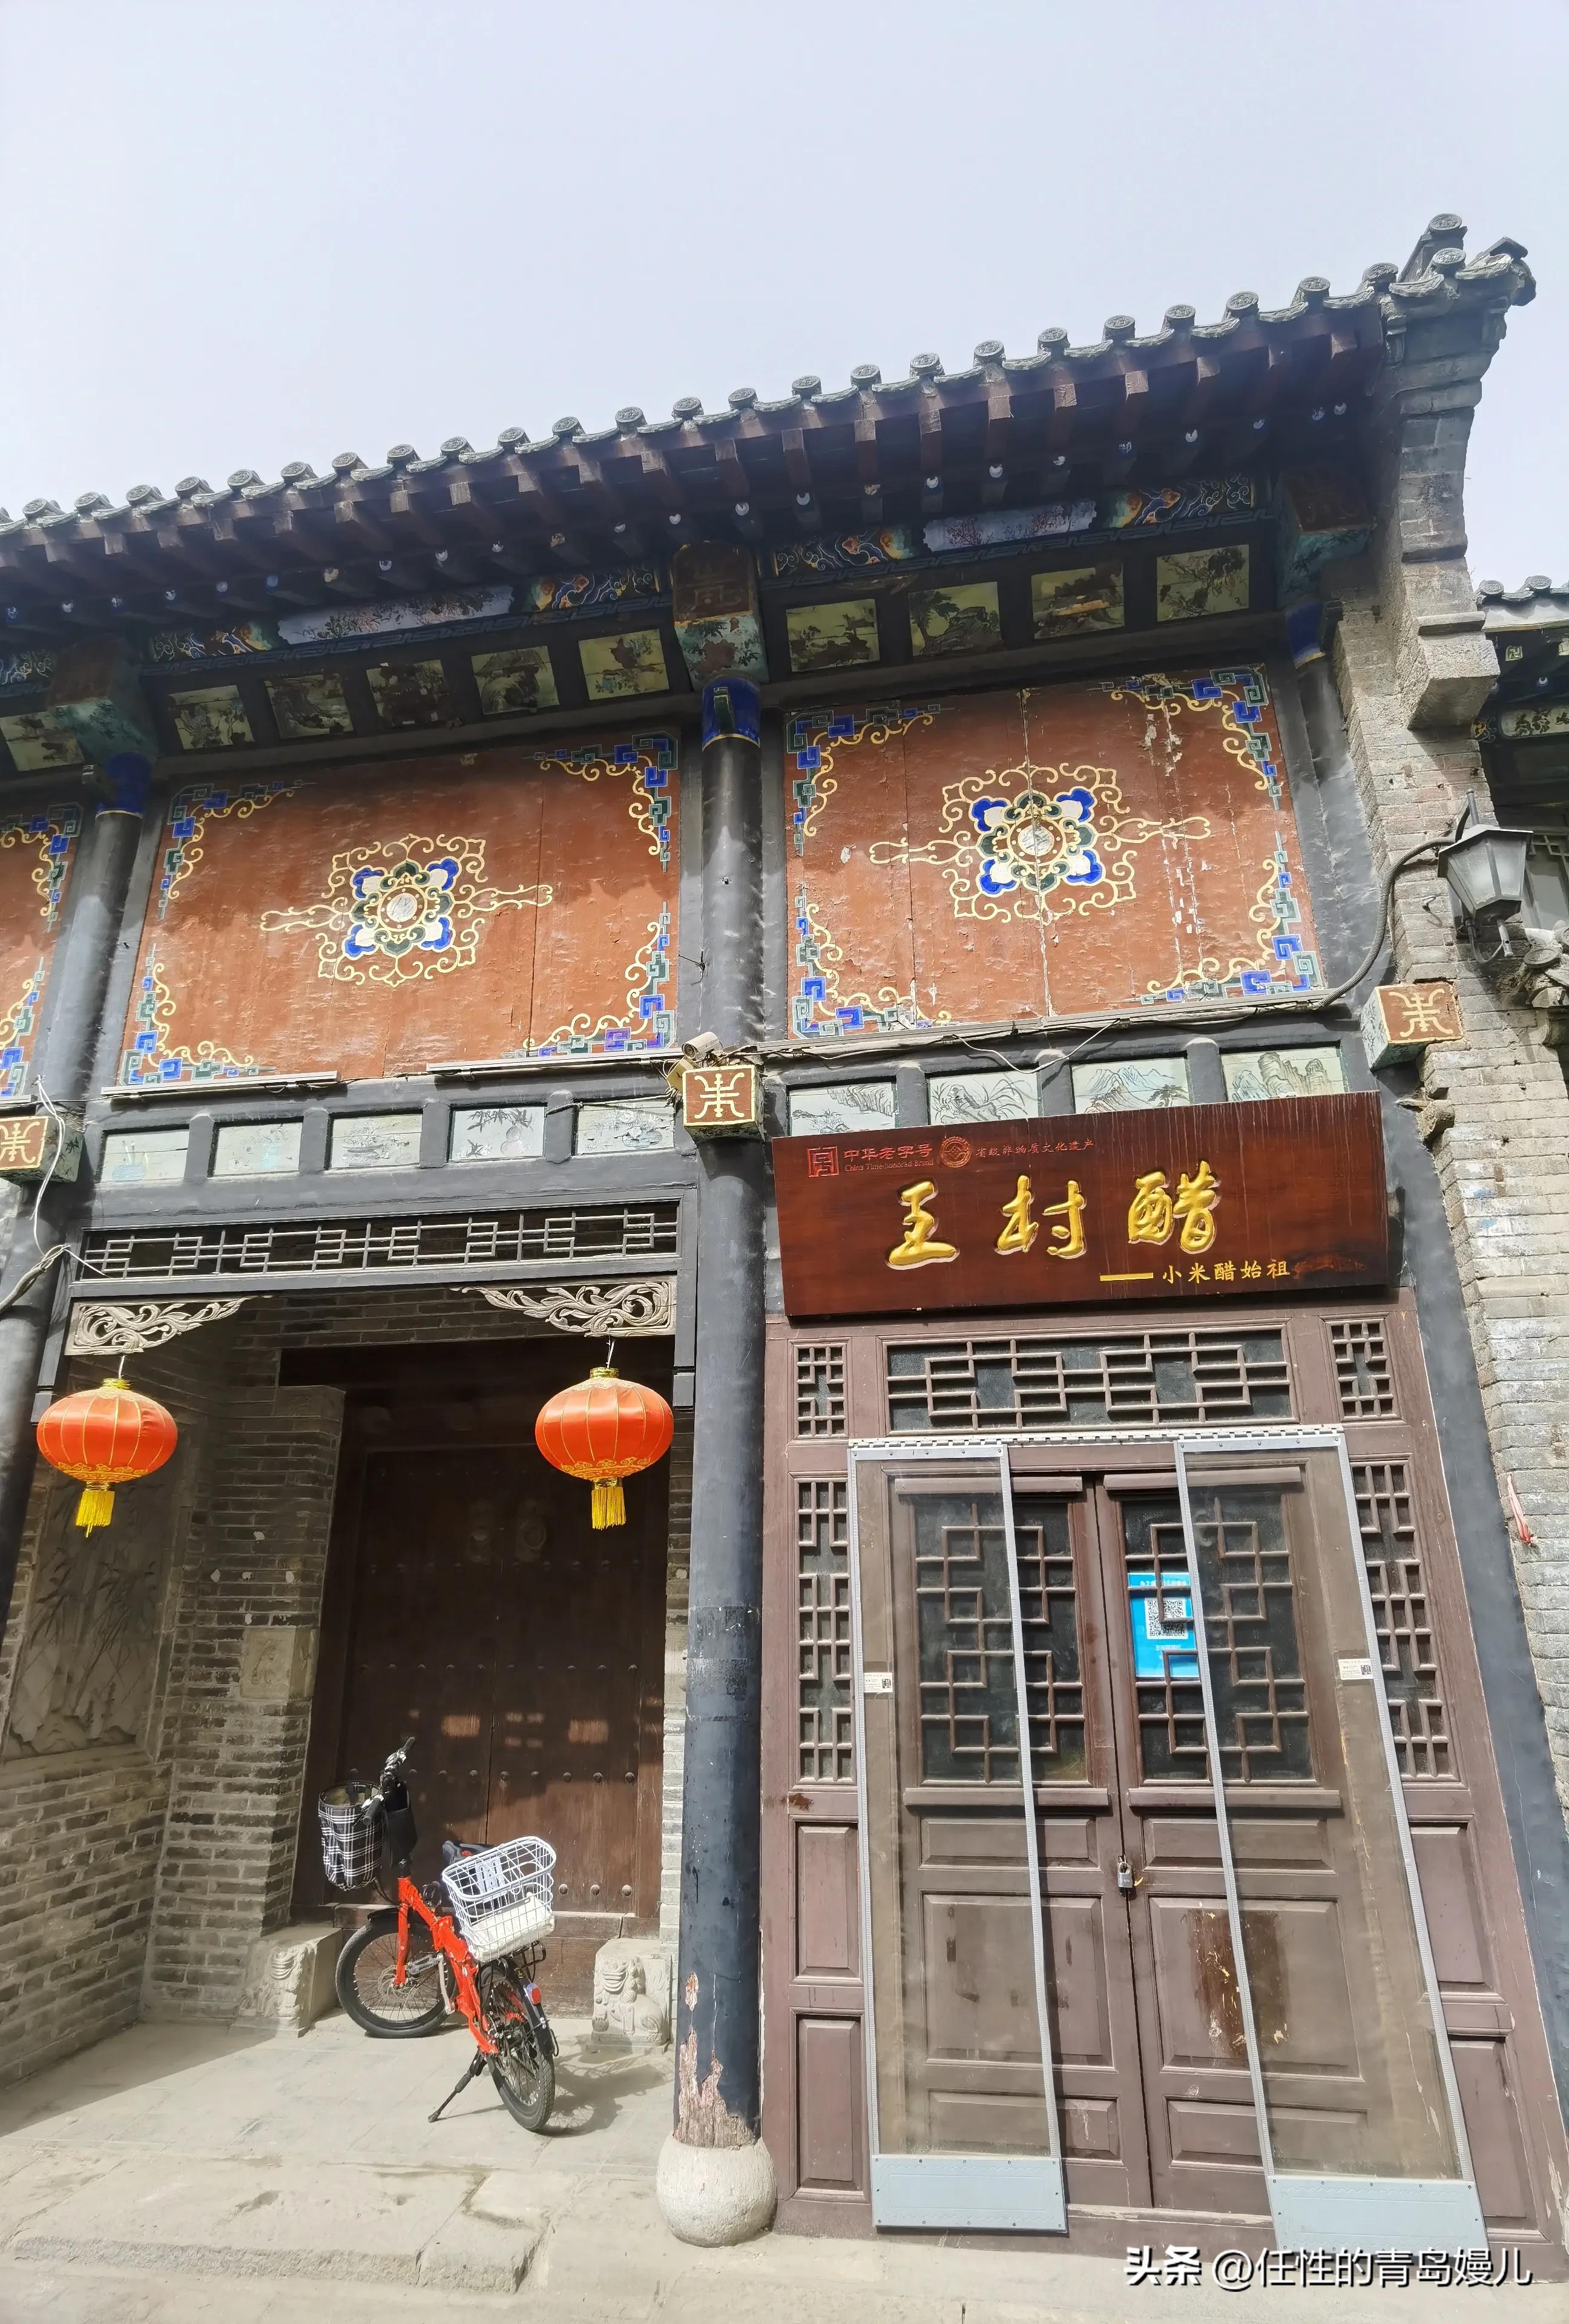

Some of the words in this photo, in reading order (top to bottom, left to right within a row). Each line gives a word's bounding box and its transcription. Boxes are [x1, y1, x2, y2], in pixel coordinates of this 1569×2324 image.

[844, 1144, 932, 1162] 中华老字号
[975, 1138, 1095, 1158] 省级非物质文化遗产
[845, 1164, 864, 1172] China
[866, 1160, 913, 1170] Time-honored
[915, 1158, 935, 1167] Brand
[886, 1161, 1219, 1267] 王村醋
[1163, 1259, 1290, 1284] 小米醋始祖
